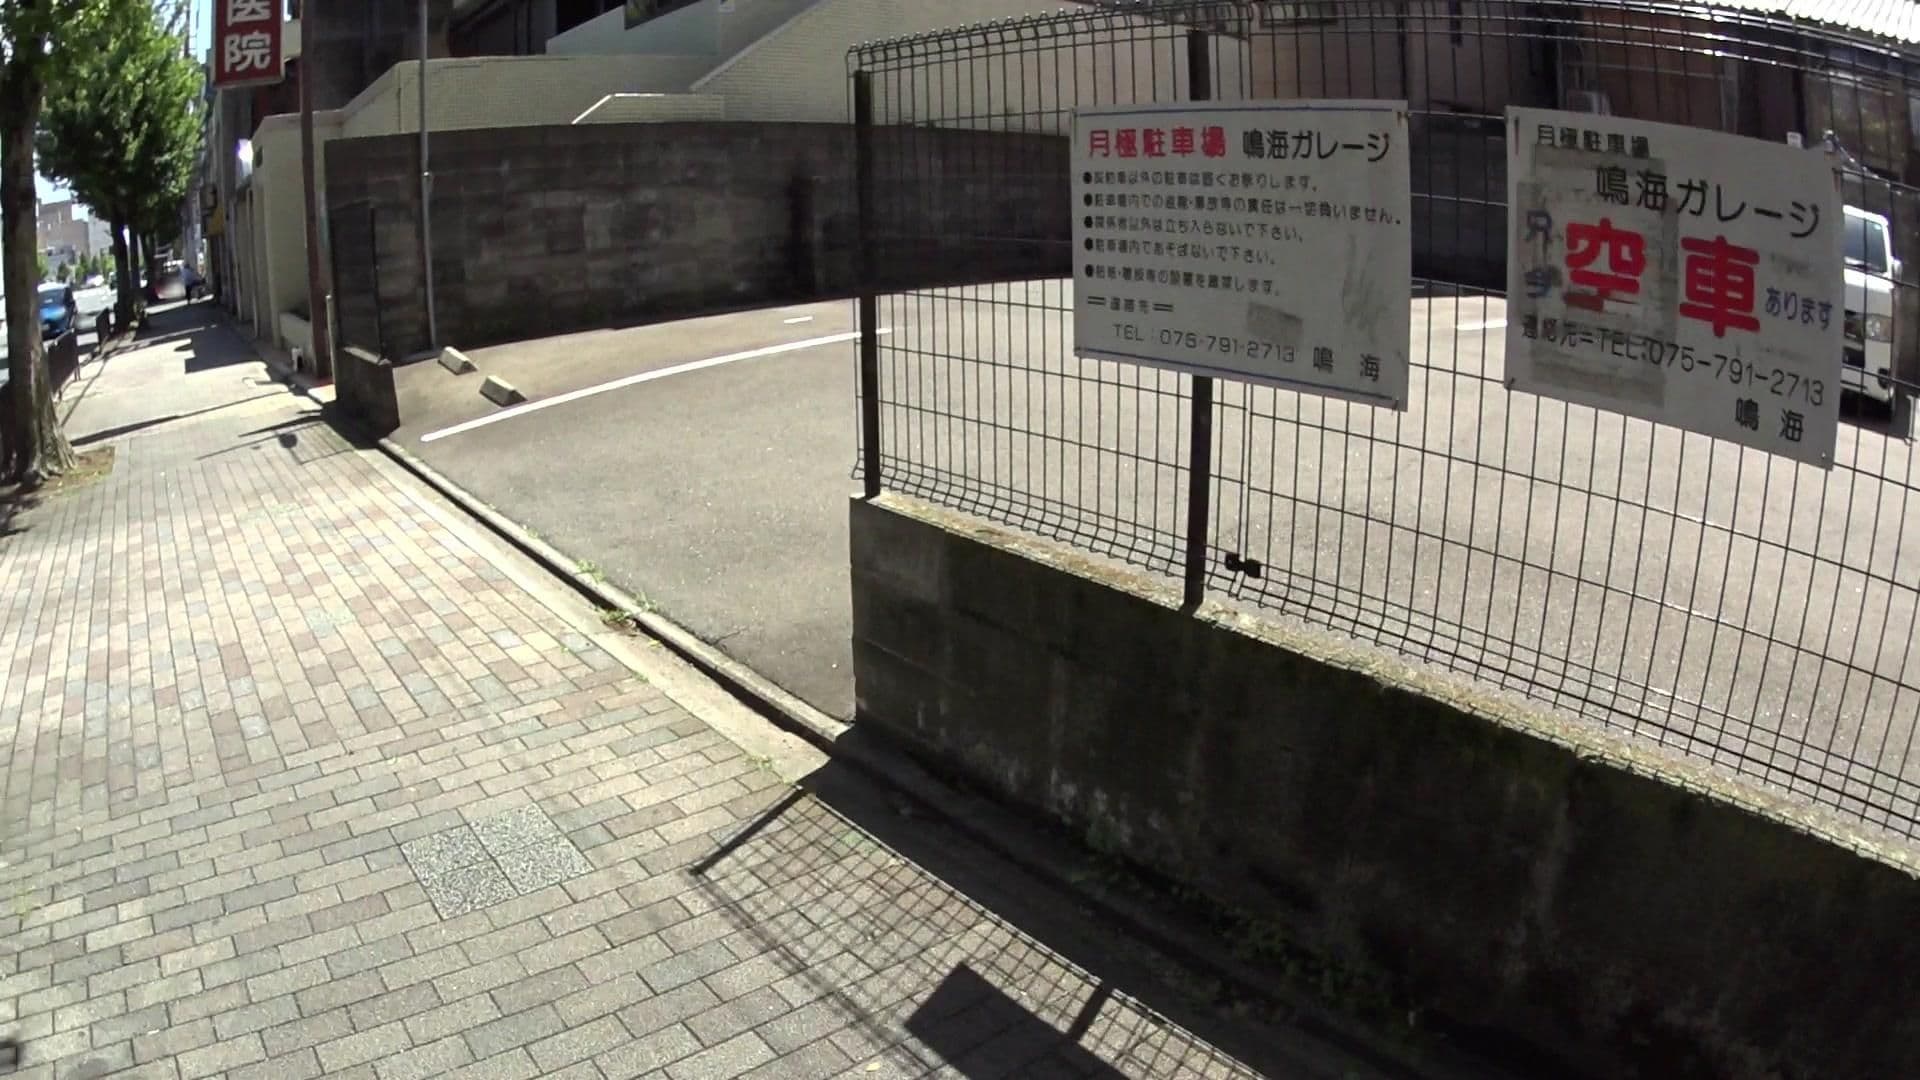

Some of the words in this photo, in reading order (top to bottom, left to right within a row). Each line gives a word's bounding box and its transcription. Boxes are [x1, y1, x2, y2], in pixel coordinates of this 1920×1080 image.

[224, 0, 272, 73] 医院
[1088, 126, 1228, 160] 月極駐車場
[1243, 128, 1391, 163] 鳴海ガレージ
[1596, 165, 1820, 239] 鳴海ガレージ
[1765, 286, 1834, 331] あります
